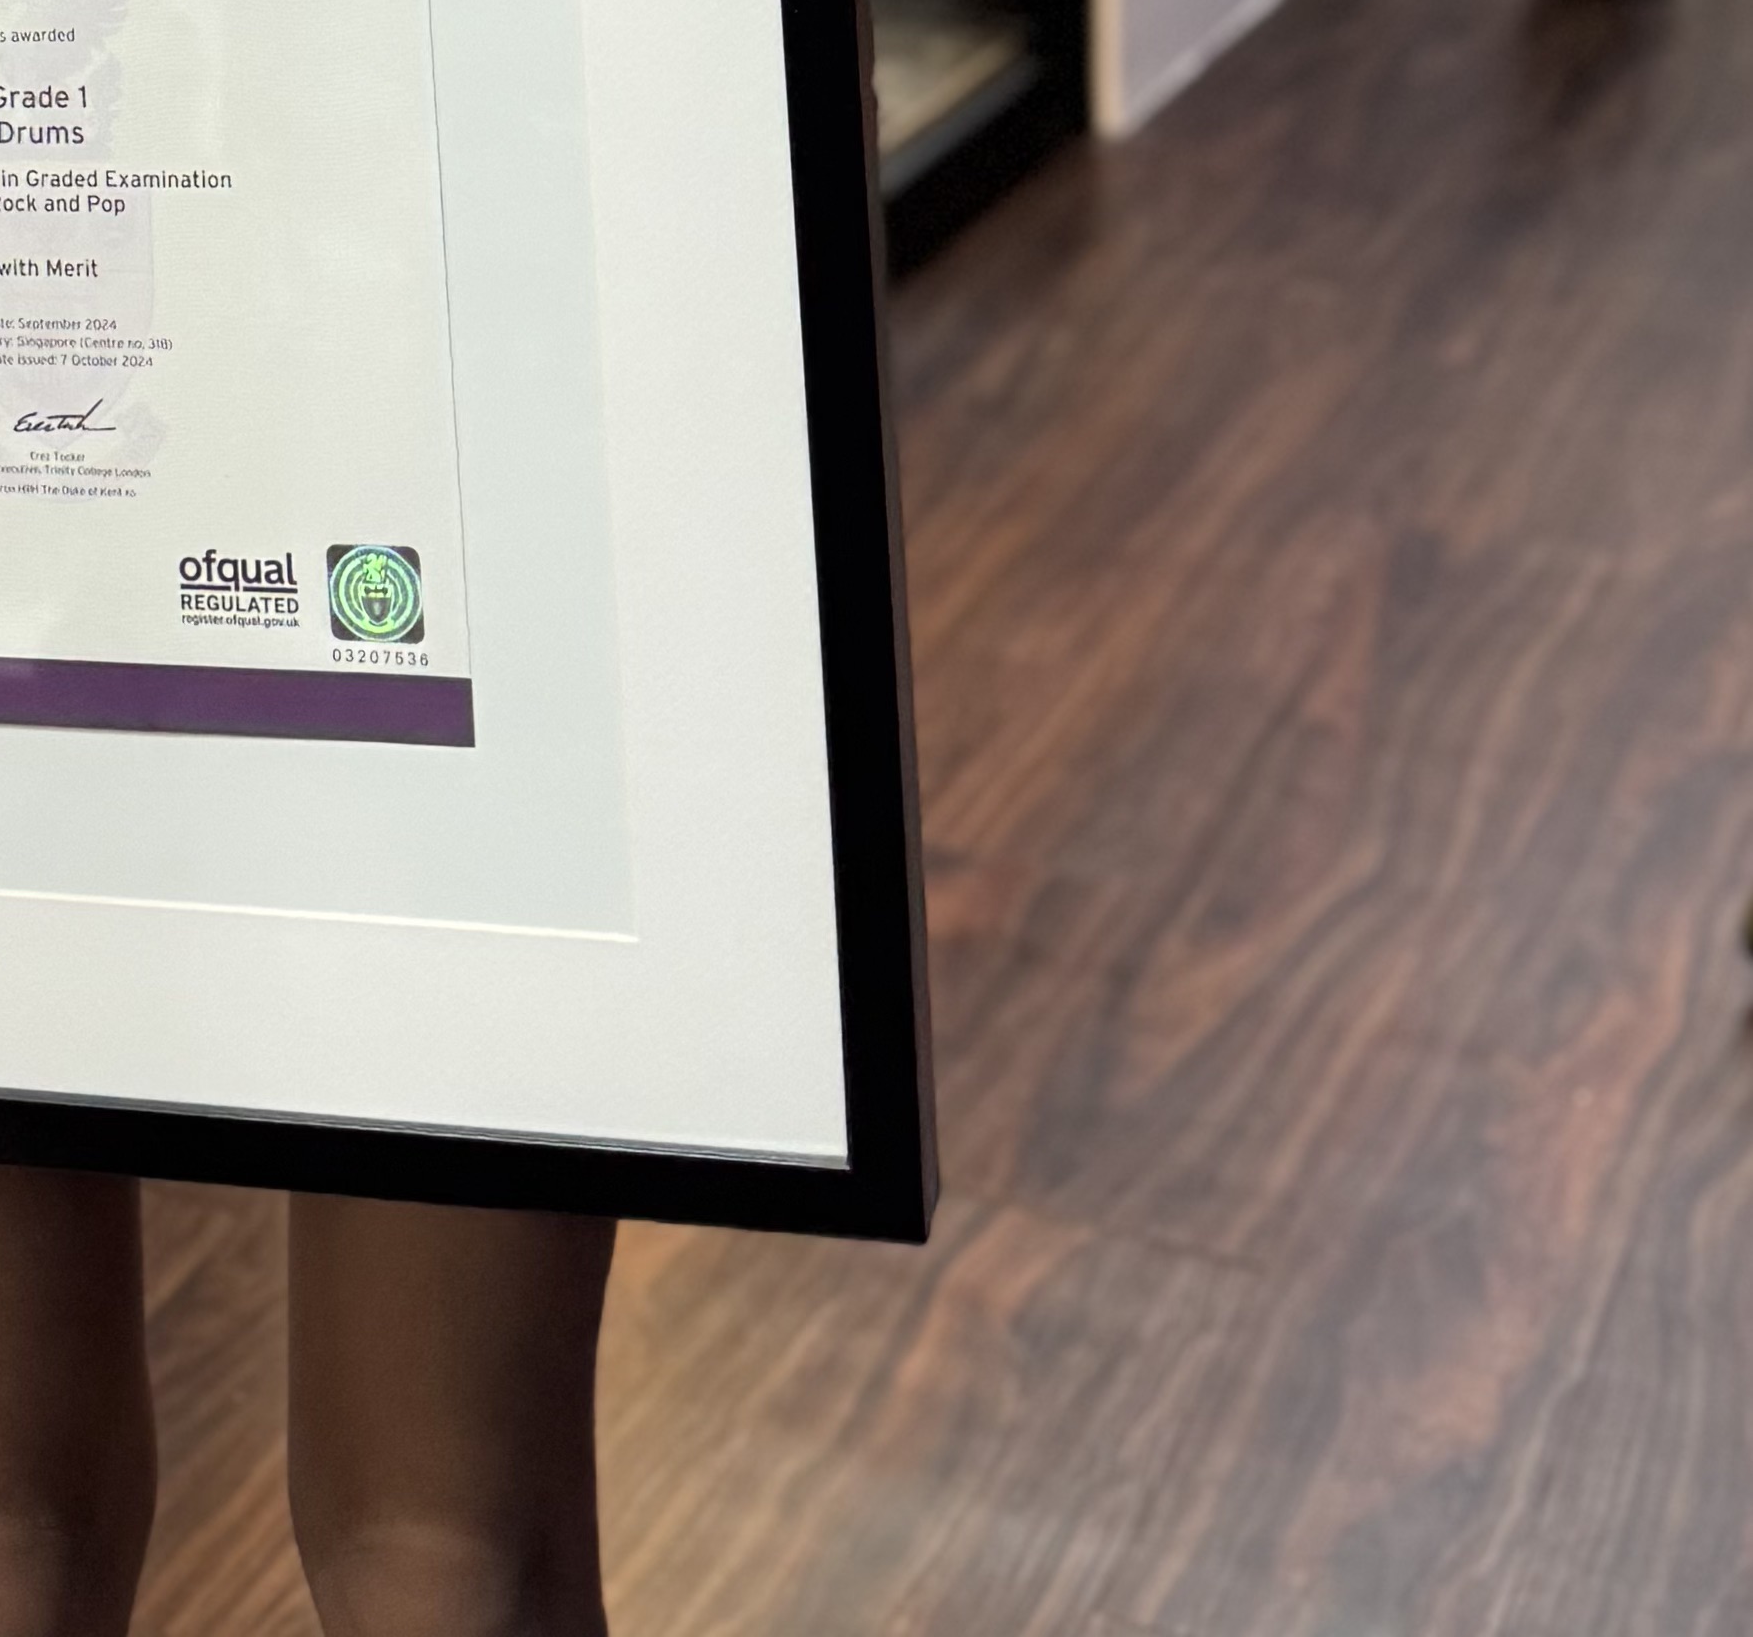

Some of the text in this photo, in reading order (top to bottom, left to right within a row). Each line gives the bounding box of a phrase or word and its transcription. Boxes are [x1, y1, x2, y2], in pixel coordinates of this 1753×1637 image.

[11, 28, 75, 42] awarded
[78, 85, 87, 108] 1
[1, 170, 19, 187] in
[26, 170, 98, 188] Graded
[105, 170, 232, 188] Examination
[44, 194, 79, 212] and
[88, 195, 126, 216] Pop
[46, 259, 98, 278] Merit
[18, 318, 81, 331] September
[85, 319, 117, 330] 2024
[17, 336, 76, 349] Singapore
[60, 355, 67, 365] 7
[72, 355, 117, 366] October
[122, 356, 153, 367] 2024
[179, 549, 298, 591] ofqual
[180, 594, 299, 613] REGULATED
[332, 648, 429, 666] 03207536
